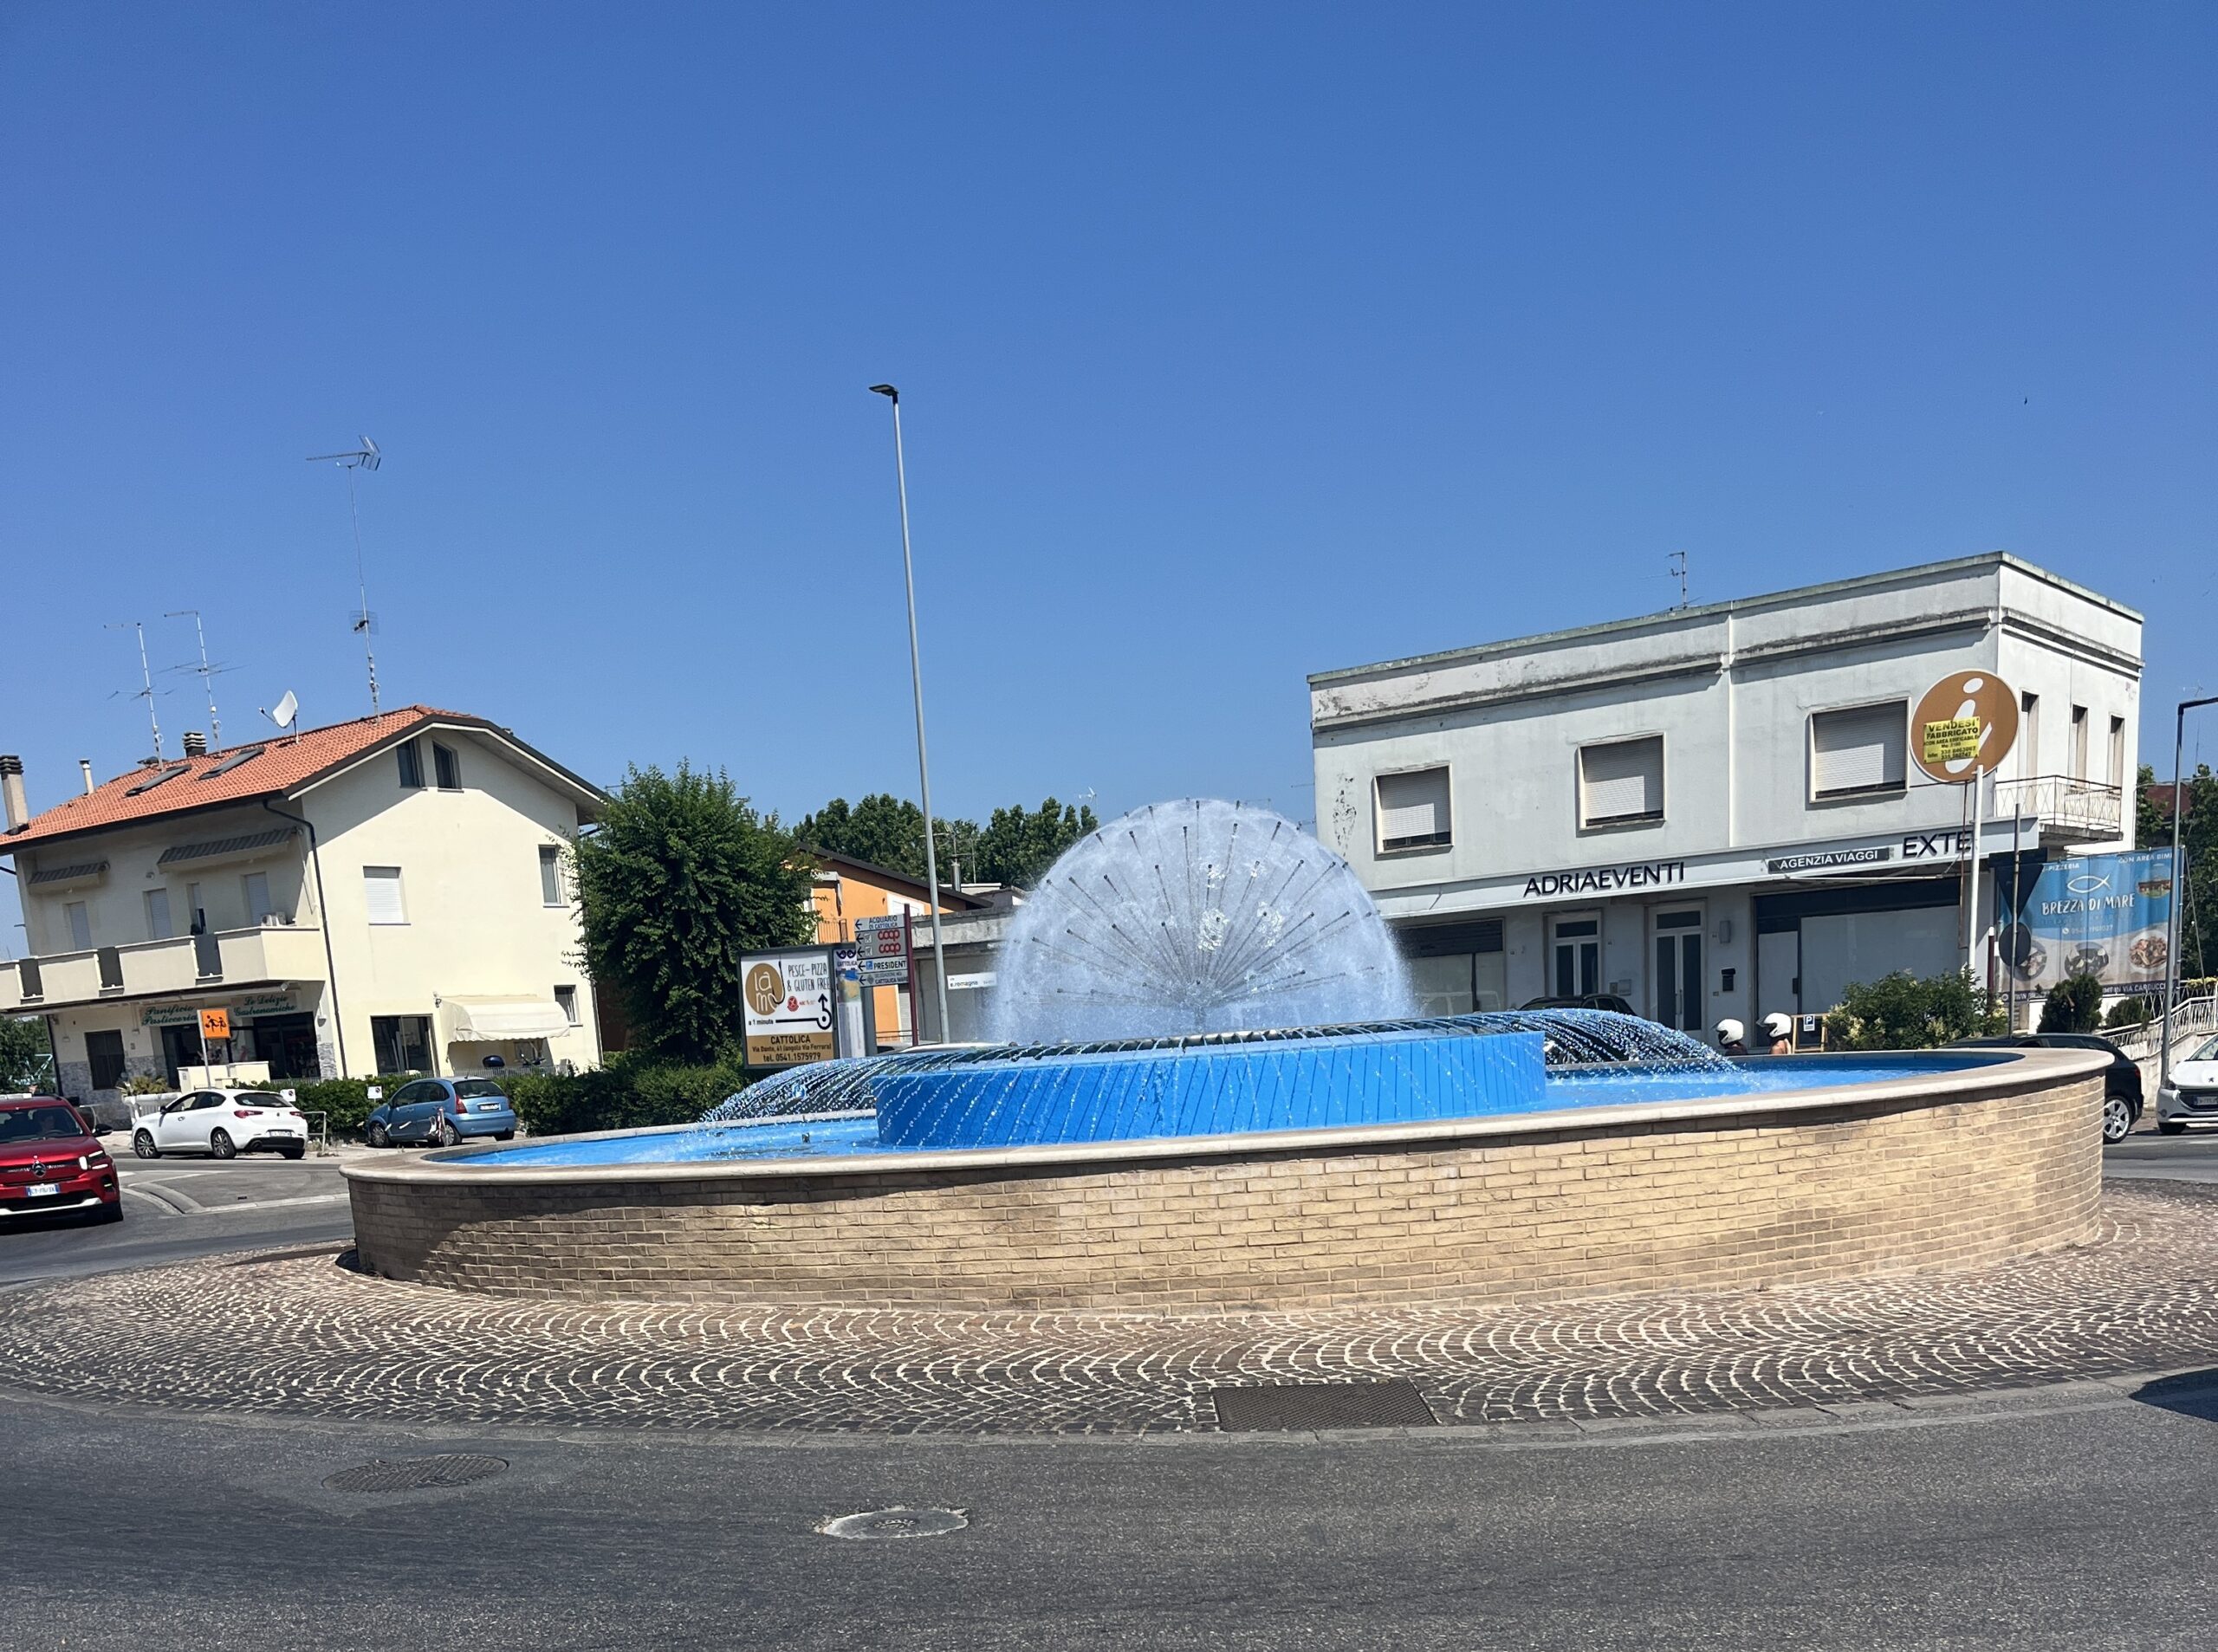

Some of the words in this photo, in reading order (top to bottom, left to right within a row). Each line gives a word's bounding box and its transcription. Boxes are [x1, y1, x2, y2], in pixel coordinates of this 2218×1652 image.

[1929, 720, 1975, 732] VENDESI
[1926, 727, 1978, 740] FABBRICATO
[1780, 855, 1833, 870] AGENZIA
[1835, 850, 1878, 864] VIAGGI
[1523, 861, 1685, 898] ADRIAEVENTI
[2041, 898, 2085, 916] BREZZA
[2088, 898, 2101, 911] DI
[2103, 893, 2136, 909] MARE
[869, 915, 898, 923] ACQUARIO
[878, 930, 900, 942] coop
[879, 943, 901, 956] coop
[873, 961, 907, 970] PRESIDENT
[794, 978, 815, 992] GLUTEN
[817, 977, 832, 990] FREE
[2134, 982, 2166, 992] CARDUCCI
[145, 1005, 194, 1016] Panificio
[770, 1034, 811, 1045] CATTOLICA
